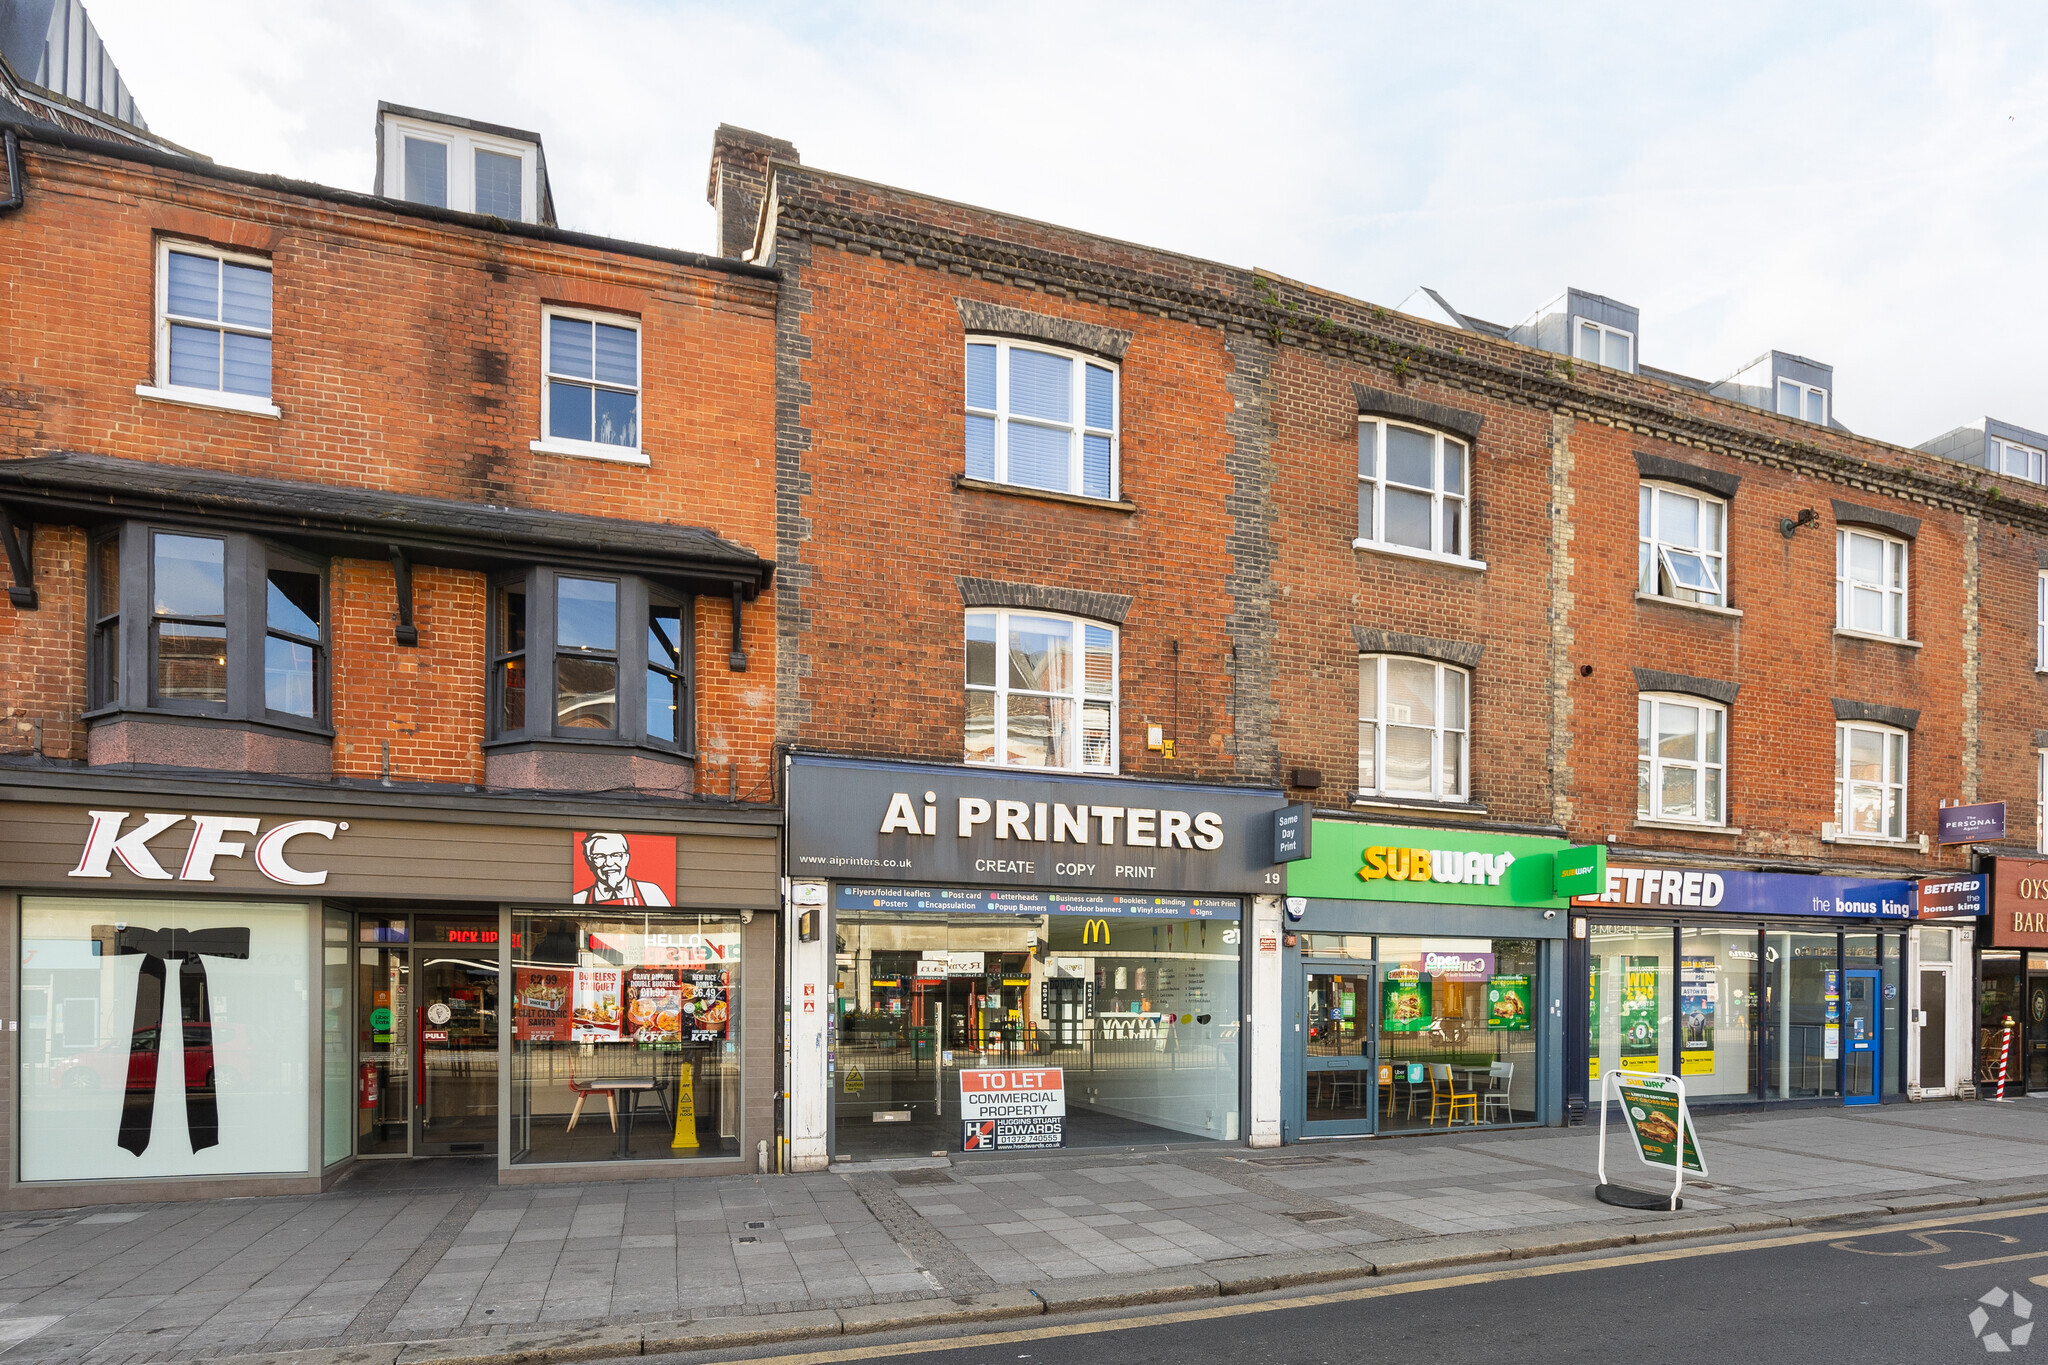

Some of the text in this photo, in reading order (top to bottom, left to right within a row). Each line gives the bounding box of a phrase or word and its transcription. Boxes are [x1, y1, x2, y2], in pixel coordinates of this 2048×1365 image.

[880, 790, 1224, 850] Ai PRINTERS
[1278, 814, 1298, 827] Same
[1945, 818, 1997, 829] PERSONAL
[1281, 828, 1295, 839] Day
[68, 810, 338, 886] KFC
[1280, 842, 1297, 852] Print
[799, 854, 912, 869] www.aiprinters.co.uk
[975, 859, 1035, 874] CREATE
[1357, 845, 1516, 886] SUBWAY
[1055, 862, 1096, 876] COPY
[1115, 865, 1157, 879] PRINT
[1560, 865, 1594, 878] SUBWAY
[1264, 873, 1281, 885] 19
[852, 887, 931, 899] Flyers/folded leaflets
[1923, 880, 1980, 895] BETFRED
[948, 891, 982, 900] Post card
[997, 893, 1039, 902] Letterheads
[1055, 894, 1104, 904] Business cards
[1119, 897, 1147, 905] Booklets
[880, 900, 908, 908] Posters
[925, 901, 976, 911] Encapsulation
[994, 902, 1048, 913] Popup Banners
[1161, 898, 1186, 907] Binding
[1199, 899, 1236, 908] T-Shirt Print
[1812, 895, 1910, 918] the bonus king
[1923, 901, 1981, 913] bonus king
[1065, 904, 1122, 914] Outdoor banners
[1136, 906, 1179, 916] Vinyl stickers
[1195, 909, 1213, 917] Signs
[644, 933, 700, 948] HELLO
[1963, 931, 1970, 939] 23
[1426, 953, 1460, 969] Open
[530, 974, 558, 985] £2.99
[578, 971, 617, 982] BONELESS
[632, 973, 674, 981] GRAVY DIPPING
[1629, 973, 1655, 987] WIN
[630, 980, 650, 988] DOUBLE
[692, 988, 716, 998] £6.49
[518, 1009, 568, 1018] CULT CLASSIC
[528, 1018, 556, 1027] SAVERS
[978, 1072, 1046, 1089] TO LET
[1626, 1078, 1665, 1088] SUBWAY
[969, 1092, 1058, 1105] COMMERCIAL
[979, 1105, 1048, 1117] PROPERTY
[997, 1124, 1062, 1135] EDWARDS
[1001, 1134, 1058, 1143] 01372 740555
